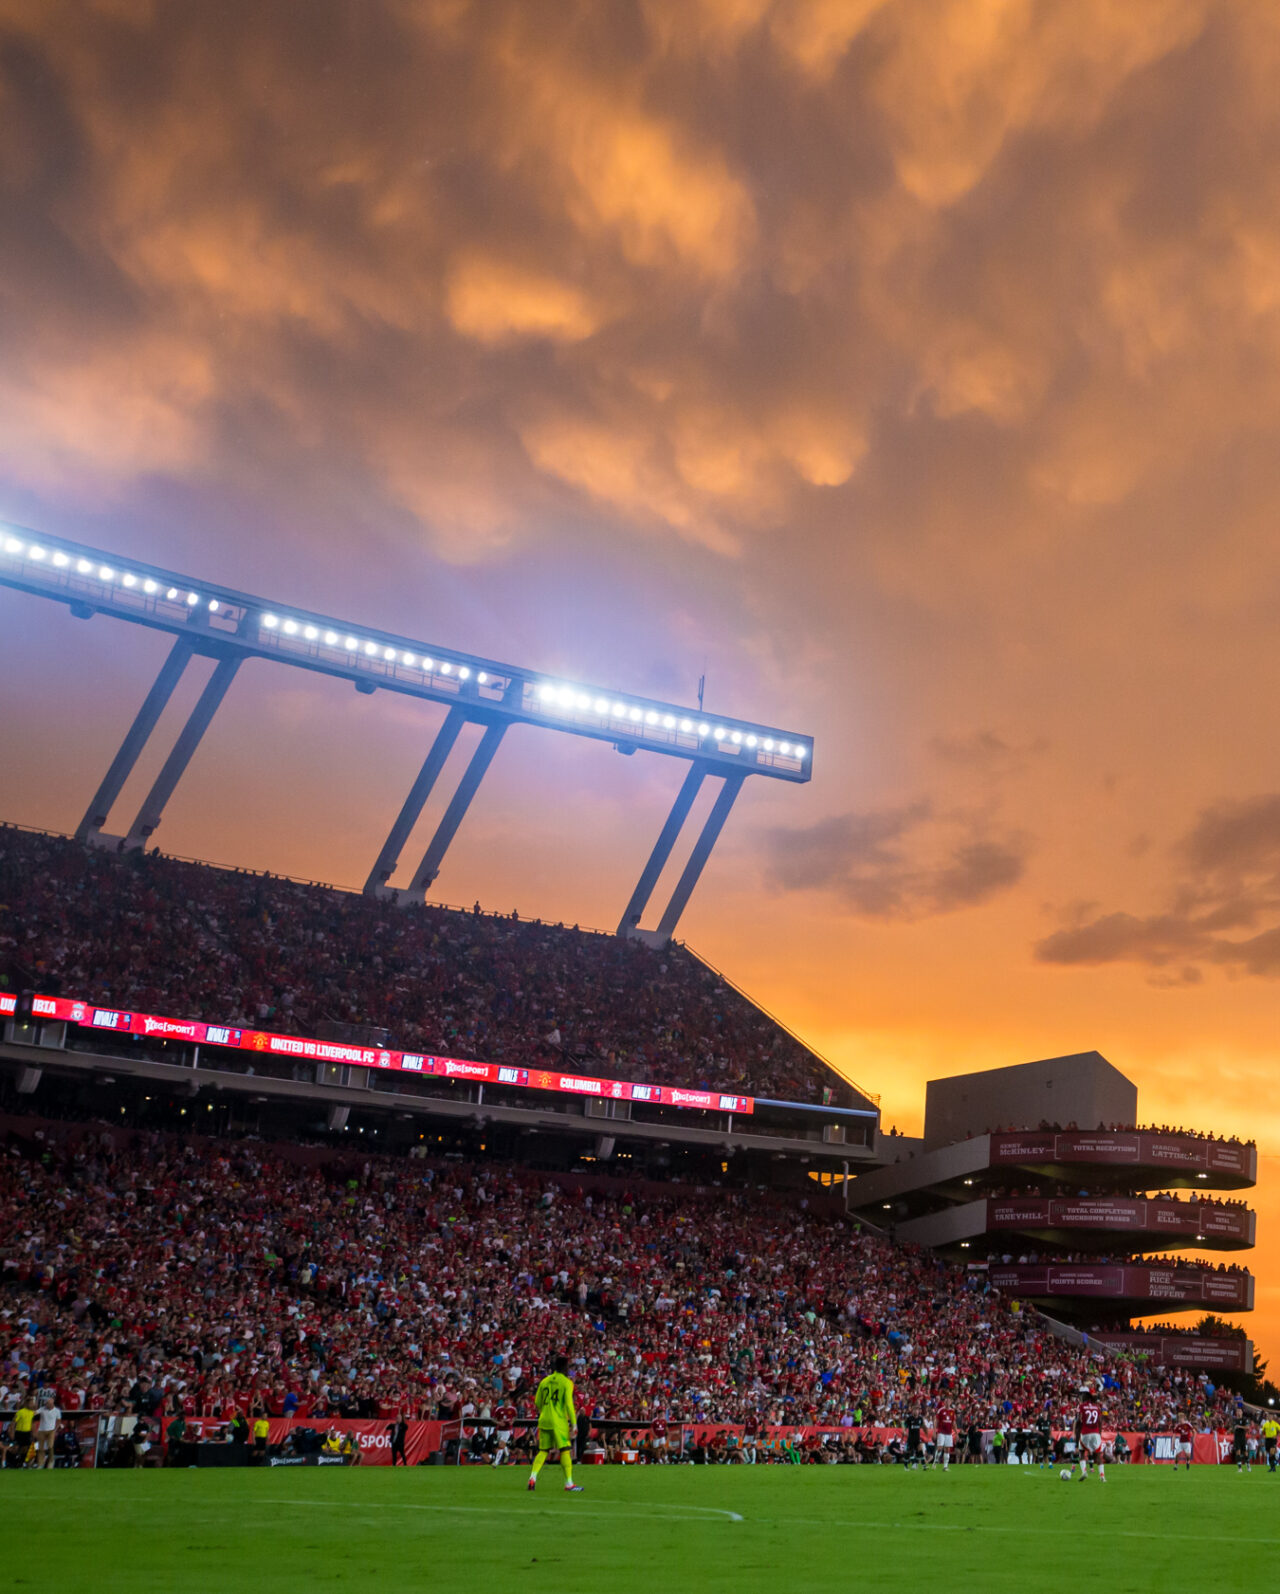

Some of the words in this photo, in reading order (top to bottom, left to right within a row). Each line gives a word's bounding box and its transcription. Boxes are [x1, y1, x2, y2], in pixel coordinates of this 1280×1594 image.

[270, 1037, 304, 1053] UNITED
[304, 1042, 316, 1054] VS
[317, 1044, 362, 1062] LIVERPOOL
[363, 1051, 375, 1063] FC
[560, 1077, 601, 1093] COLUMBIA
[543, 1387, 560, 1406] 24
[1085, 1410, 1098, 1424] 29
